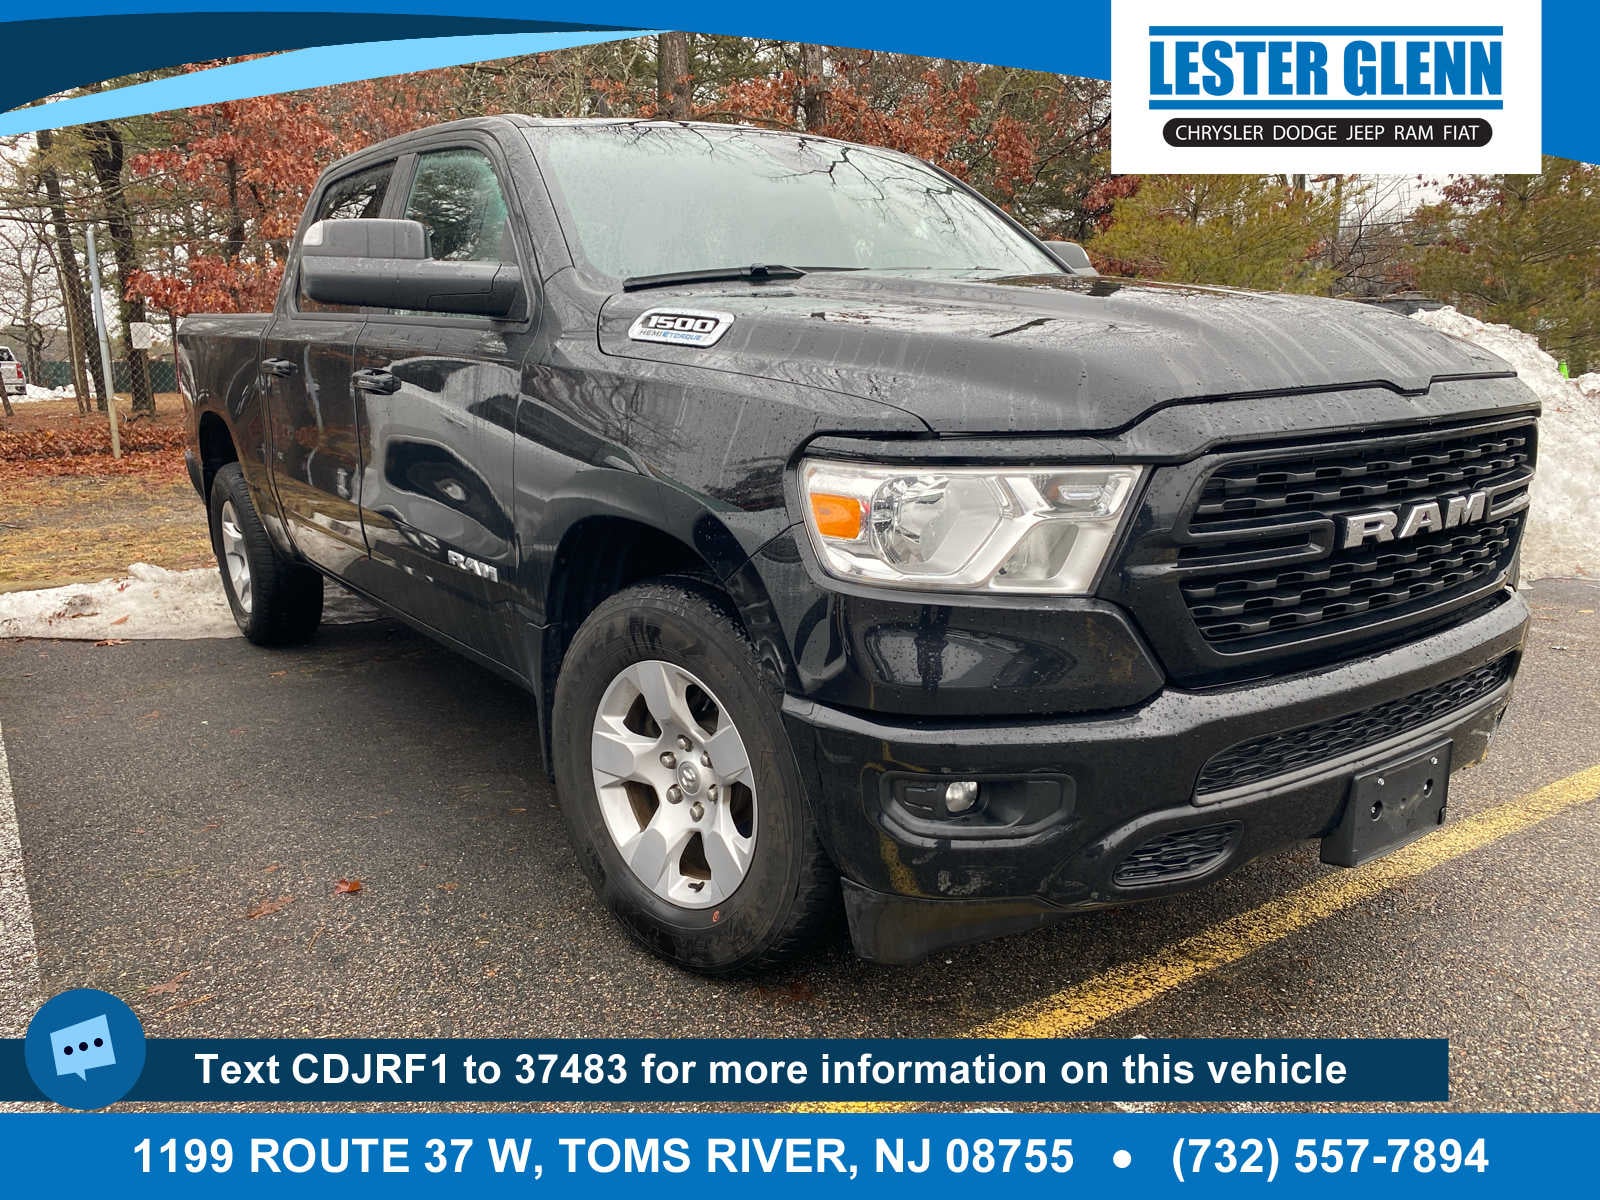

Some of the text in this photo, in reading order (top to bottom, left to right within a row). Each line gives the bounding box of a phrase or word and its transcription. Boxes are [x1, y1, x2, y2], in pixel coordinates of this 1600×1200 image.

[647, 315, 717, 332] 1500
[1343, 491, 1487, 549] RAM
[447, 549, 498, 583] RAM
